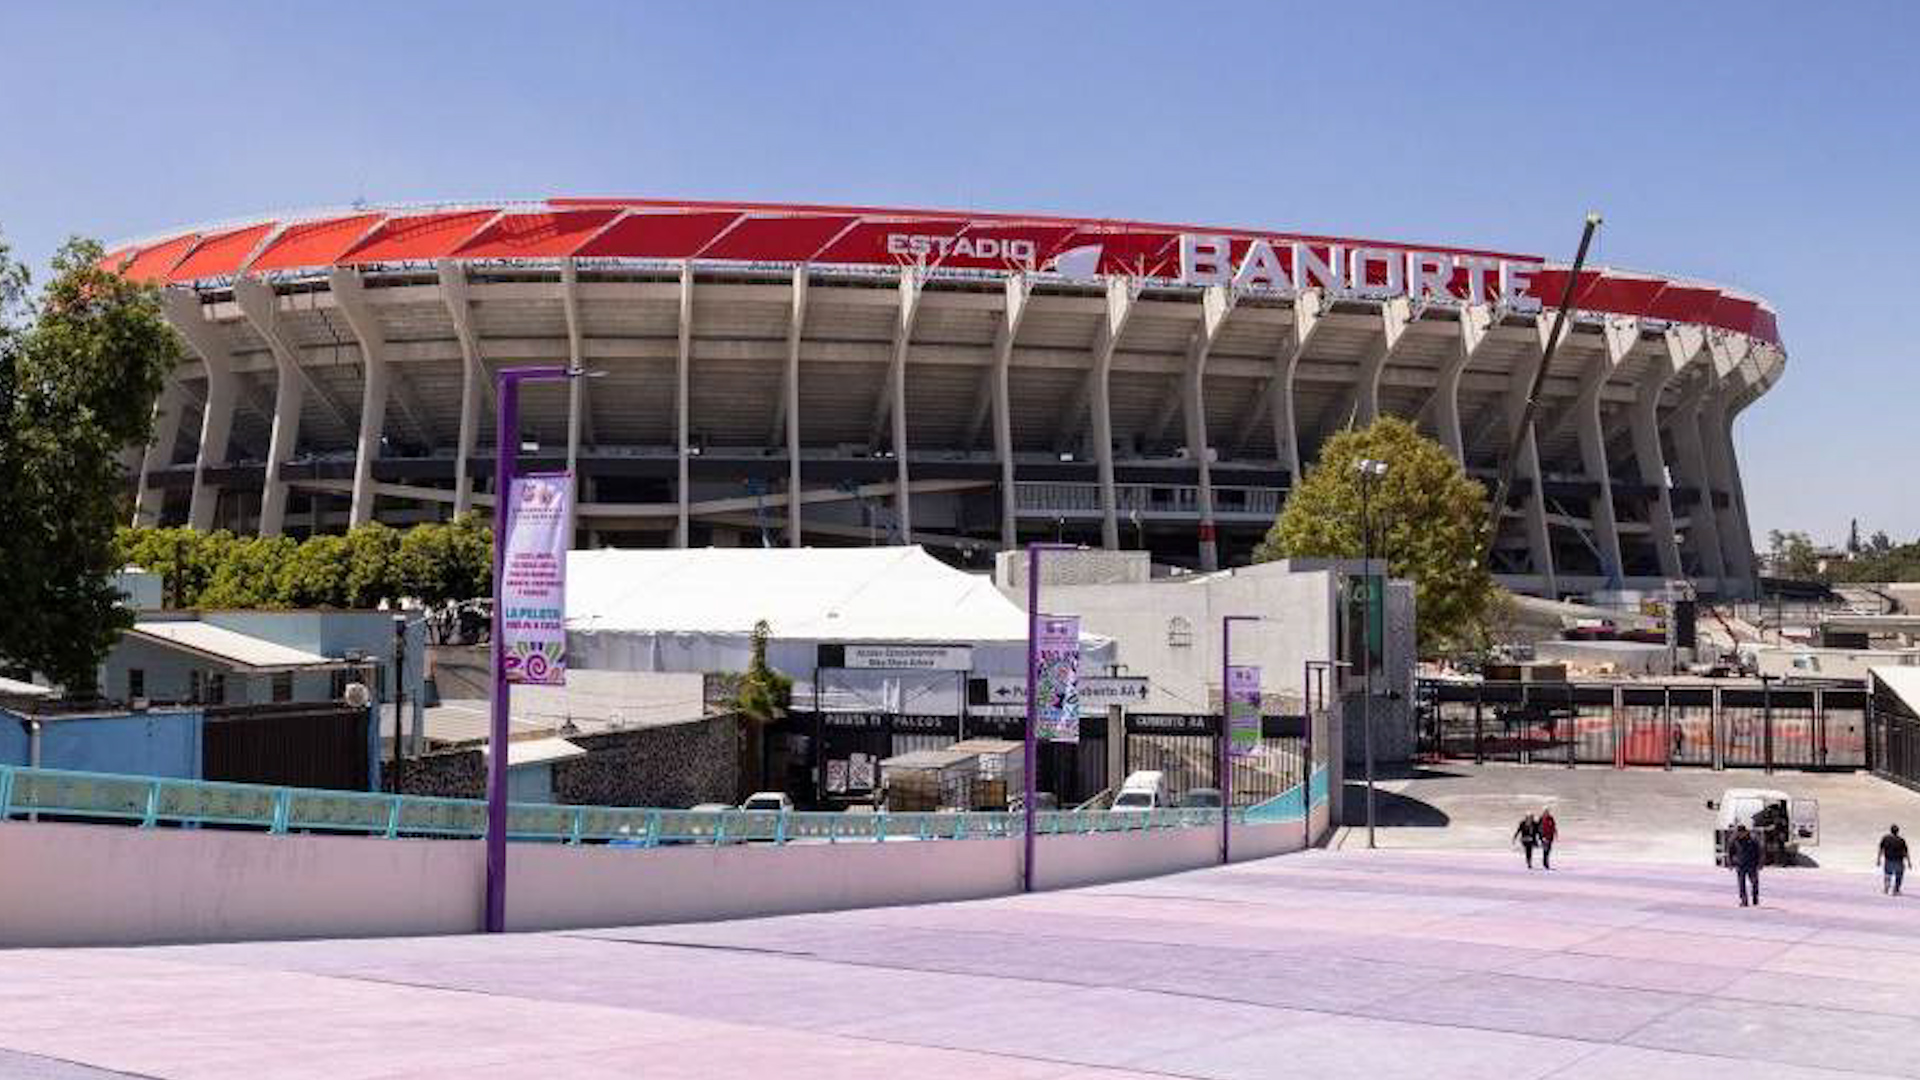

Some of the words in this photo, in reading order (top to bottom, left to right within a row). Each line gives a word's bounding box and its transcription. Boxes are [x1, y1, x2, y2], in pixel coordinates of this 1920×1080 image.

[887, 234, 1035, 259] ESTADIO
[1179, 235, 1543, 313] BANORTE
[892, 716, 942, 727] PALCOS
